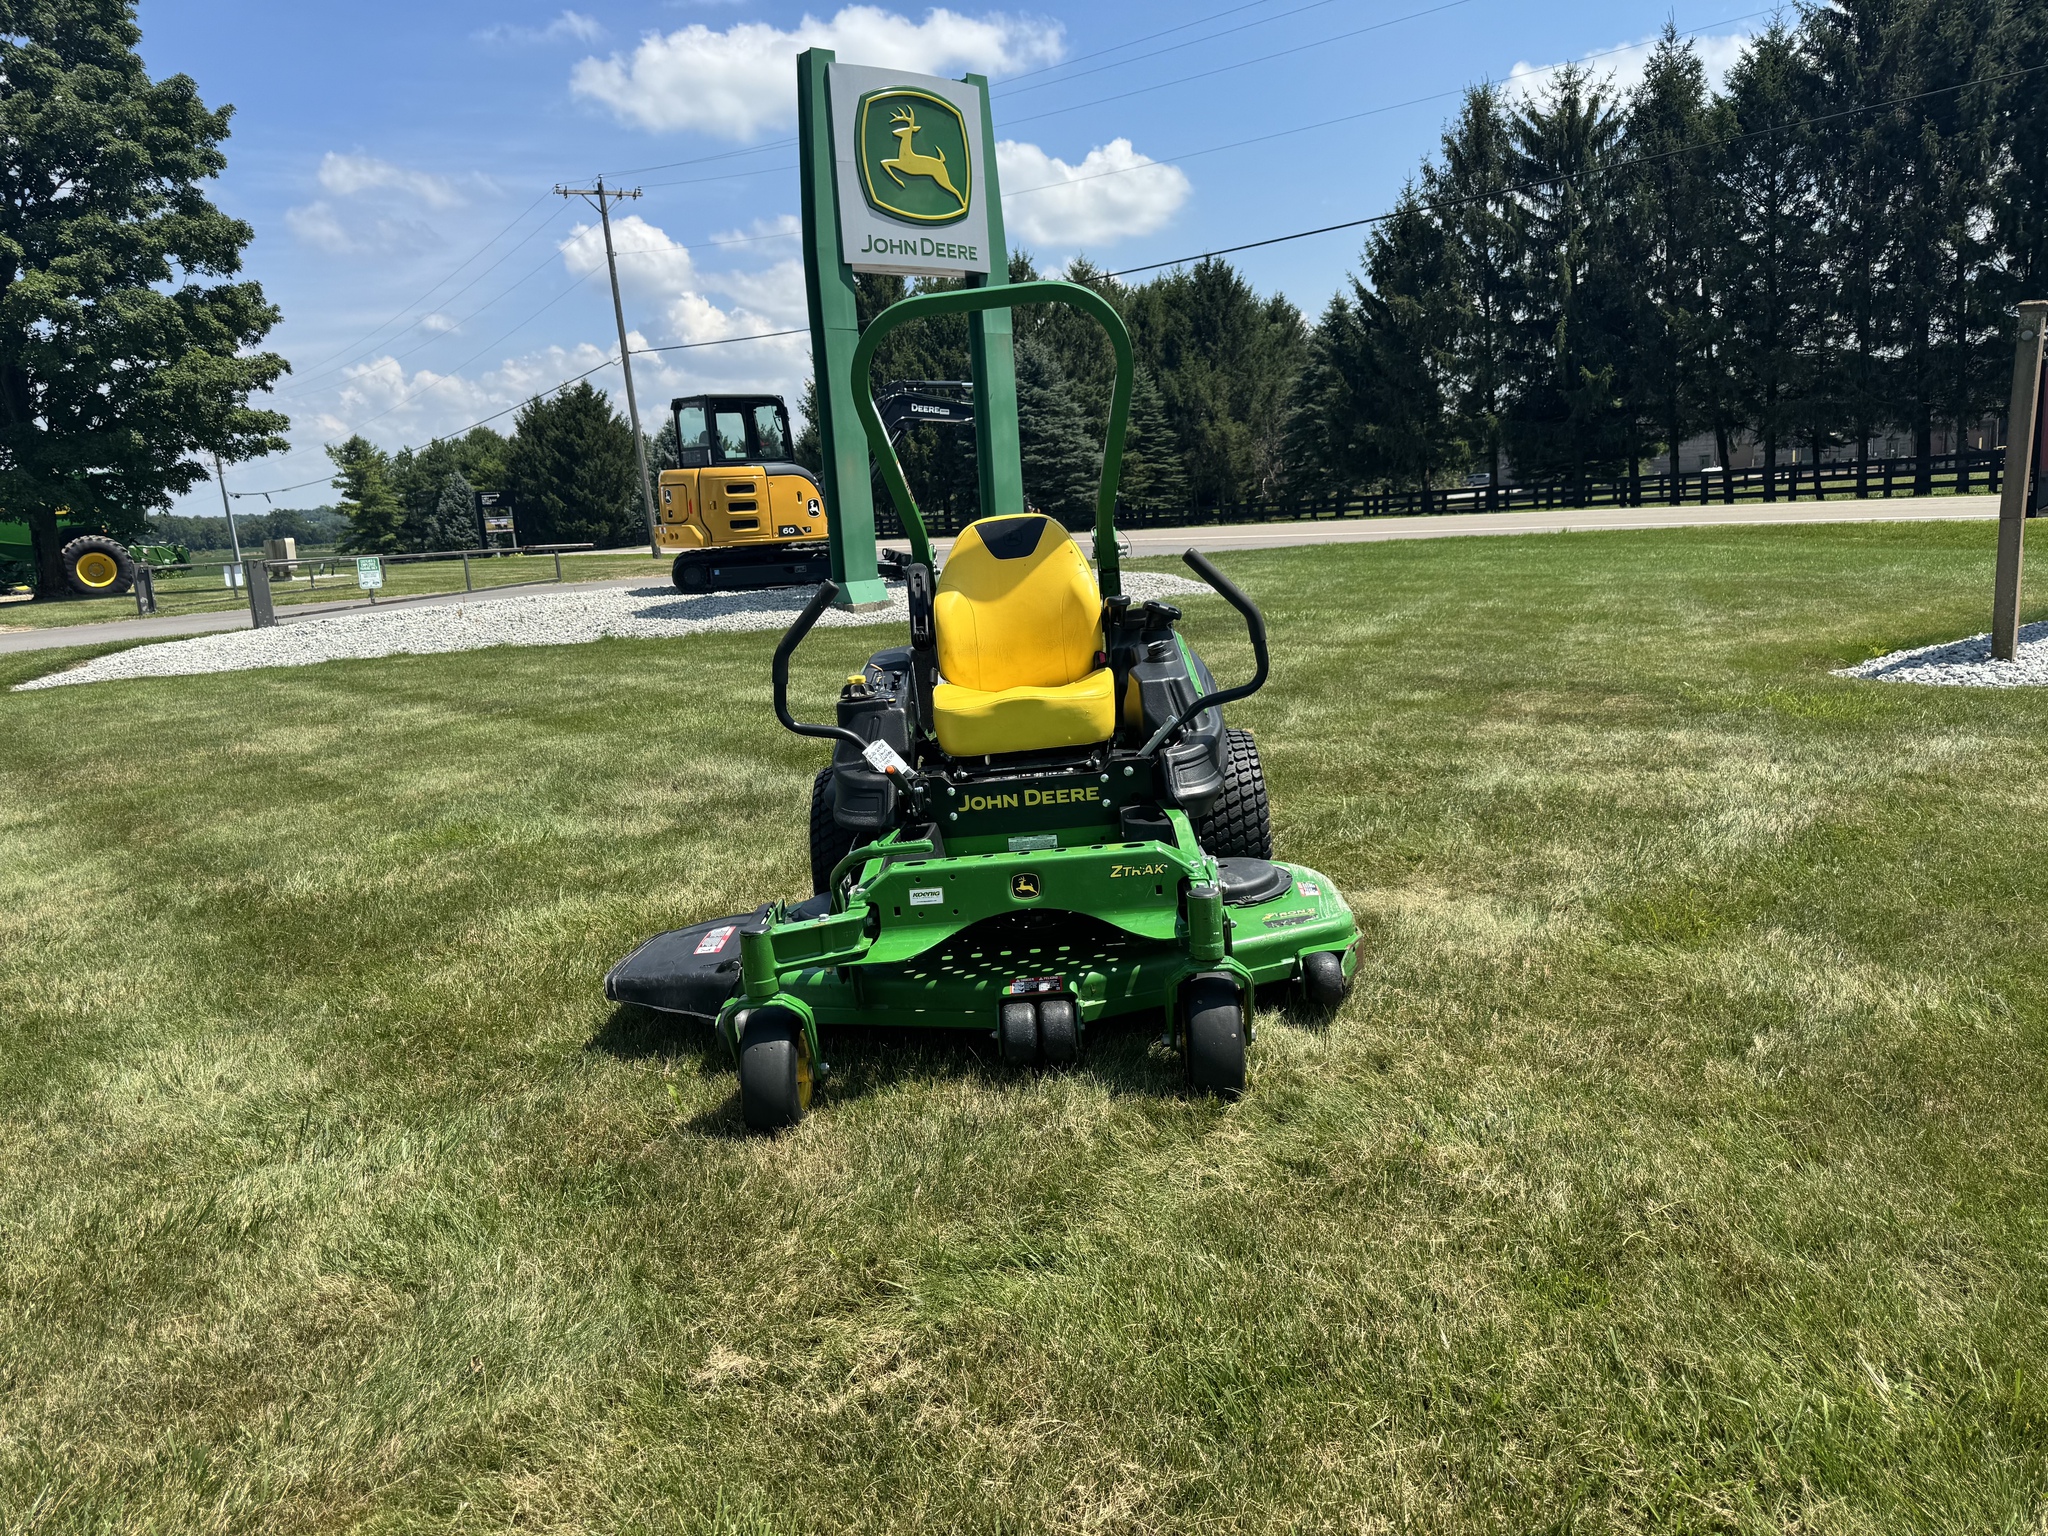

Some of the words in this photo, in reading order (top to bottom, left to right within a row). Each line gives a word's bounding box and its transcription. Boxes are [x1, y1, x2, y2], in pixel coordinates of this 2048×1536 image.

[861, 234, 917, 256] JOHN
[920, 238, 978, 261] DEERE
[911, 403, 940, 414] DEERE
[782, 526, 795, 535] 60
[958, 793, 1019, 812] JOHN
[1024, 786, 1100, 806] DEERE
